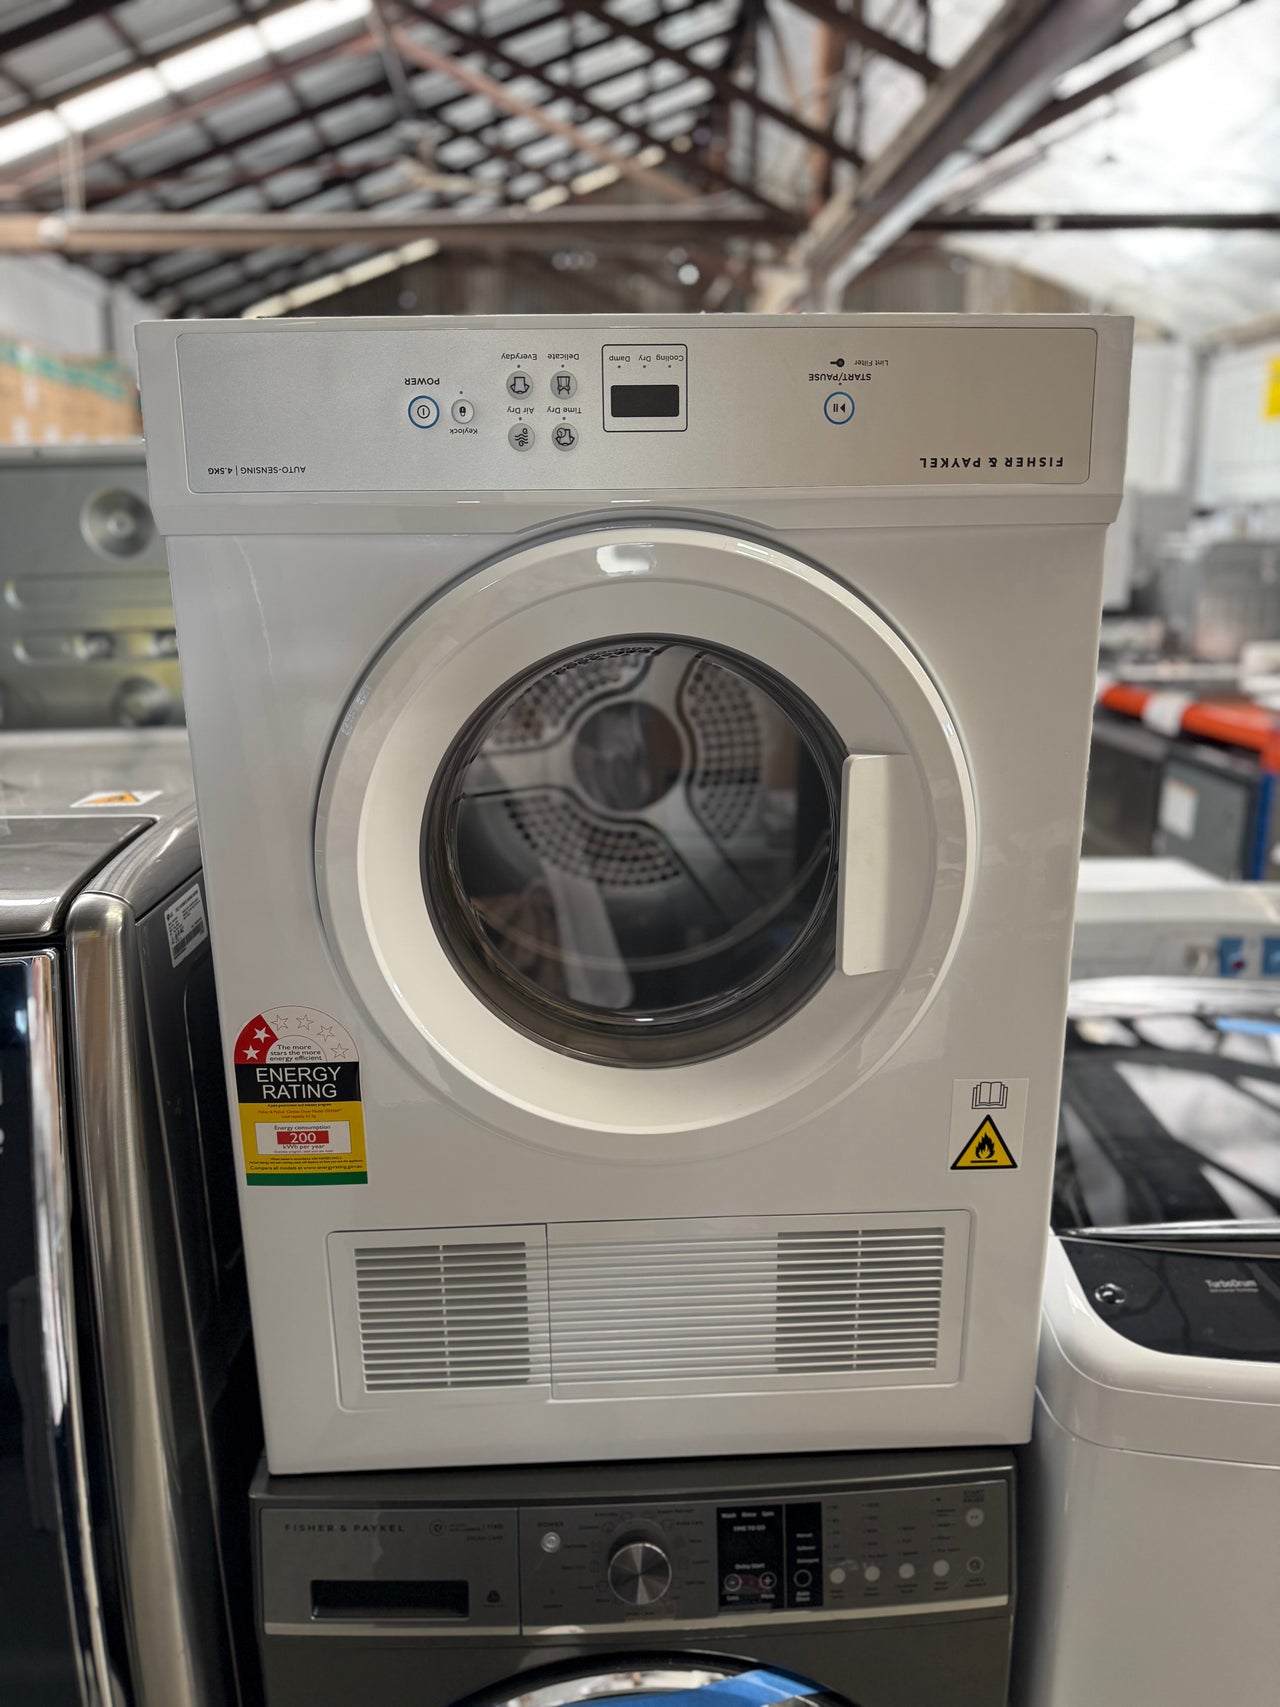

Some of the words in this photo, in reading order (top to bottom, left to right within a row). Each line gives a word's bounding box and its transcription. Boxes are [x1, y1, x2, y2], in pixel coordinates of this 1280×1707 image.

[501, 352, 538, 361] Everyday
[547, 353, 580, 361] Delicate
[608, 354, 631, 362] Damp
[638, 354, 651, 362] Dry
[655, 353, 684, 362] Cooling
[854, 359, 873, 367] Filter
[875, 359, 889, 367] Lint
[404, 377, 440, 385] POWER
[808, 372, 872, 381] START/PAUSE
[506, 406, 522, 414] Dry
[523, 406, 535, 414] Air
[546, 405, 561, 414] Dry
[449, 427, 478, 435] Keylock
[919, 457, 981, 468] PAYKEL
[988, 457, 997, 467] &
[1004, 457, 1063, 467] FISHER
[207, 467, 233, 475] 4.5KG
[240, 466, 306, 475] AUTO-SENSING
[256, 1066, 341, 1083] ENERGY
[262, 1084, 337, 1100] RATING
[290, 1132, 317, 1143] 200
[284, 1523, 335, 1532] FISHER
[340, 1524, 347, 1532] &
[353, 1523, 405, 1532] PAYKEL
